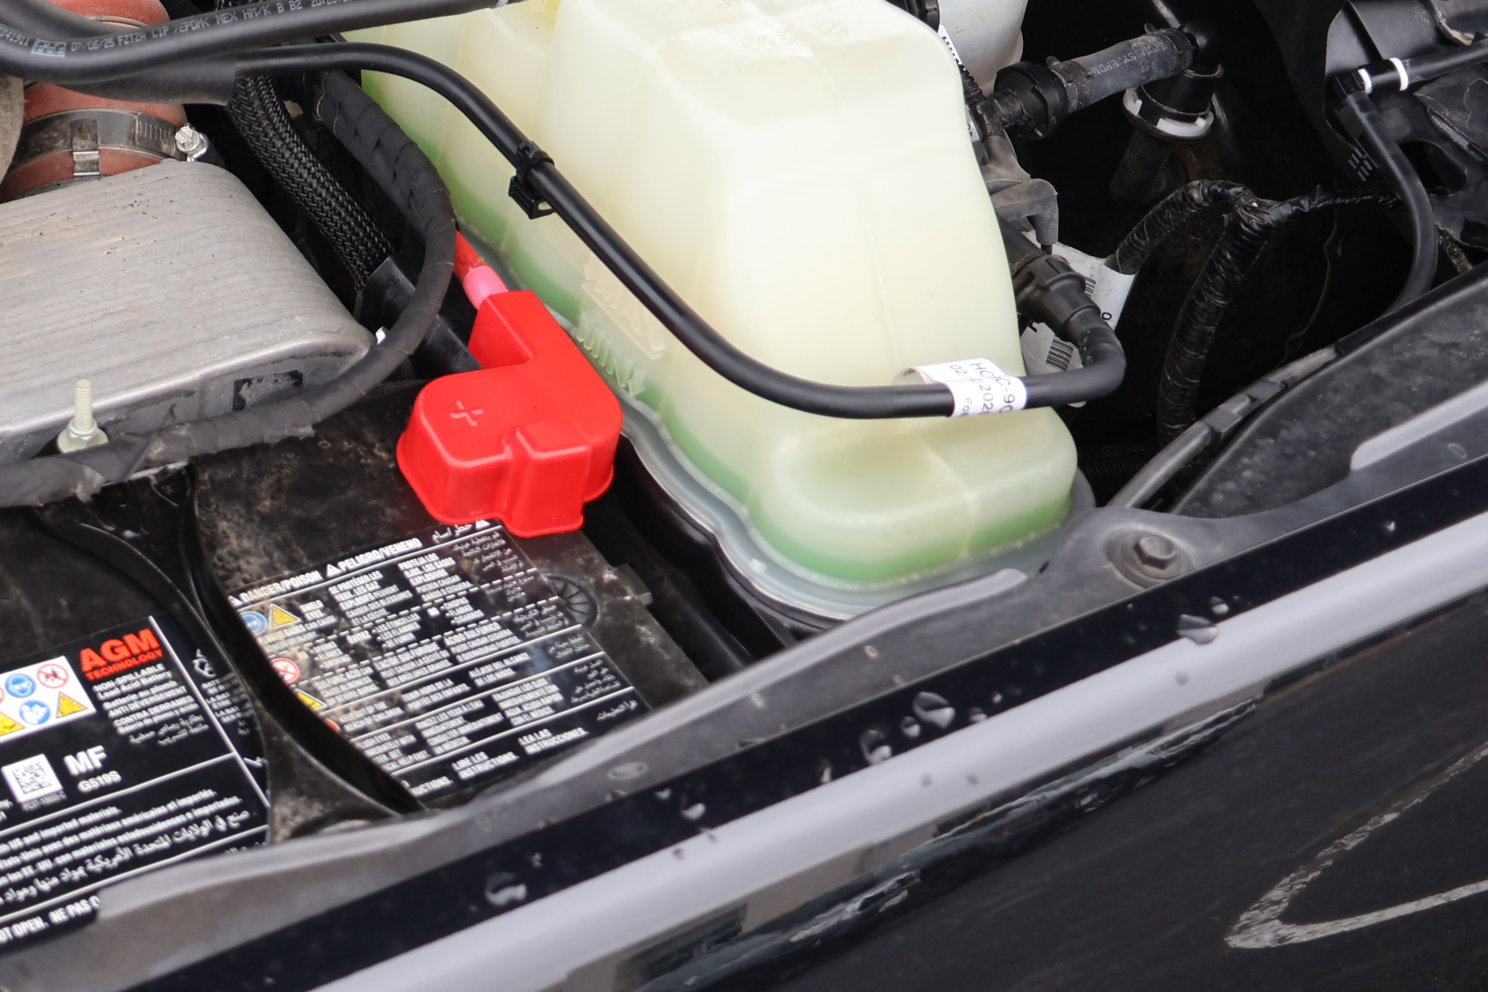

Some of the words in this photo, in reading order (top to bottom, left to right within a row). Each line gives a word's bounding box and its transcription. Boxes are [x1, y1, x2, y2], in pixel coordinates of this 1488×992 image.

[239, 570, 322, 603] DANGER/POISON
[337, 537, 422, 571] PELIGRO/VENENO
[79, 628, 159, 672] AGM
[85, 648, 162, 680] TECHNOLOGY
[92, 662, 165, 692] NON-SPILLABLE
[96, 685, 121, 700] Lead
[119, 678, 141, 693] Acid
[138, 670, 172, 686] Battery
[101, 692, 139, 710] Batterie
[136, 688, 151, 699] au
[148, 679, 178, 696] plomb
[107, 704, 130, 718] ANTI
[112, 709, 150, 728] CONTRA
[147, 694, 194, 715] DERRAMES
[517, 733, 537, 746] LEA
[532, 727, 552, 741] LAS
[524, 726, 586, 754] INSTRUCCIONES.
[63, 744, 106, 775] MF
[451, 756, 473, 771] LIRE
[469, 750, 488, 764] LES
[458, 751, 517, 779] INSTRUCTIONS.
[77, 769, 121, 792] G519S
[7, 836, 24, 850] US
[21, 830, 42, 846] and
[38, 817, 79, 839] imported
[76, 805, 121, 826] materials.
[10, 915, 48, 937] OPEN.
[48, 906, 69, 923] NE
[64, 898, 92, 917] PAS
